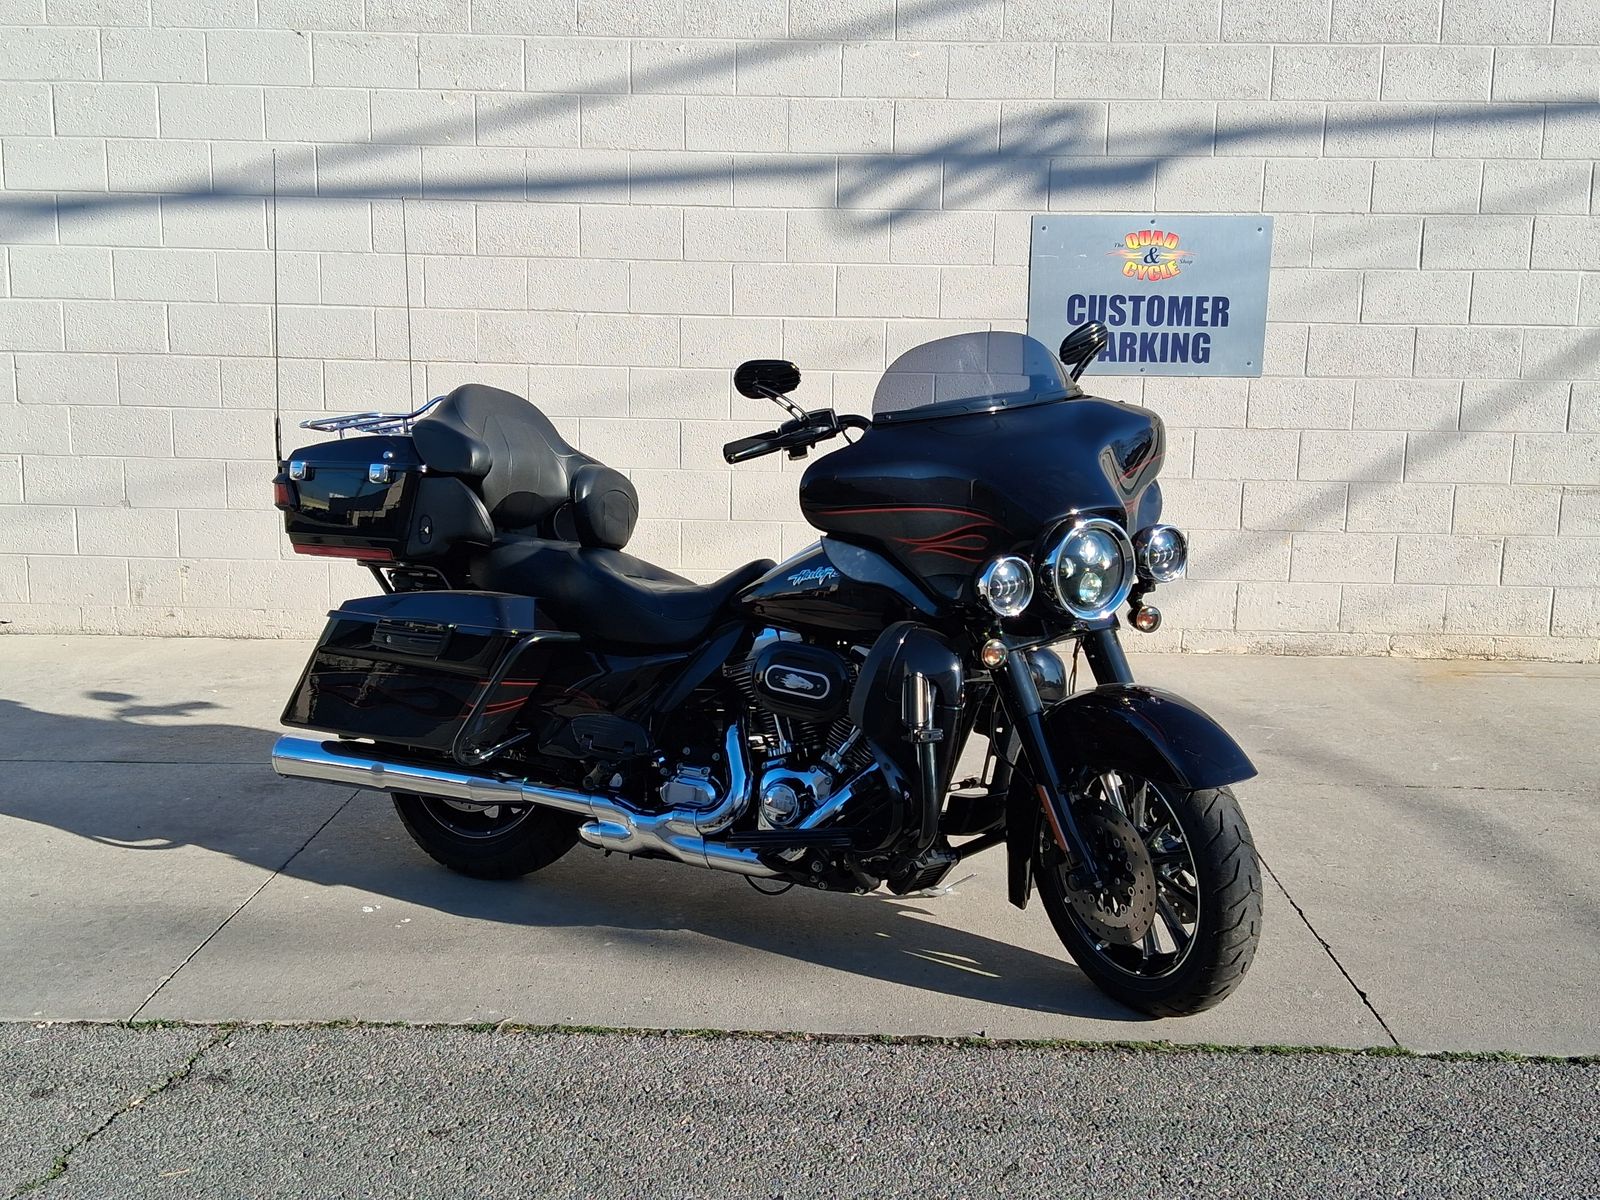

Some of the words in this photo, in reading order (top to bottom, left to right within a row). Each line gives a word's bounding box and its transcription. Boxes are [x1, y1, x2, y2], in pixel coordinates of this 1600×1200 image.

[1125, 229, 1180, 250] QUAD
[1143, 246, 1160, 264] &
[1122, 259, 1181, 281] CYCLE
[1066, 294, 1230, 328] CUSTOMER
[1097, 331, 1211, 364] ARKING
